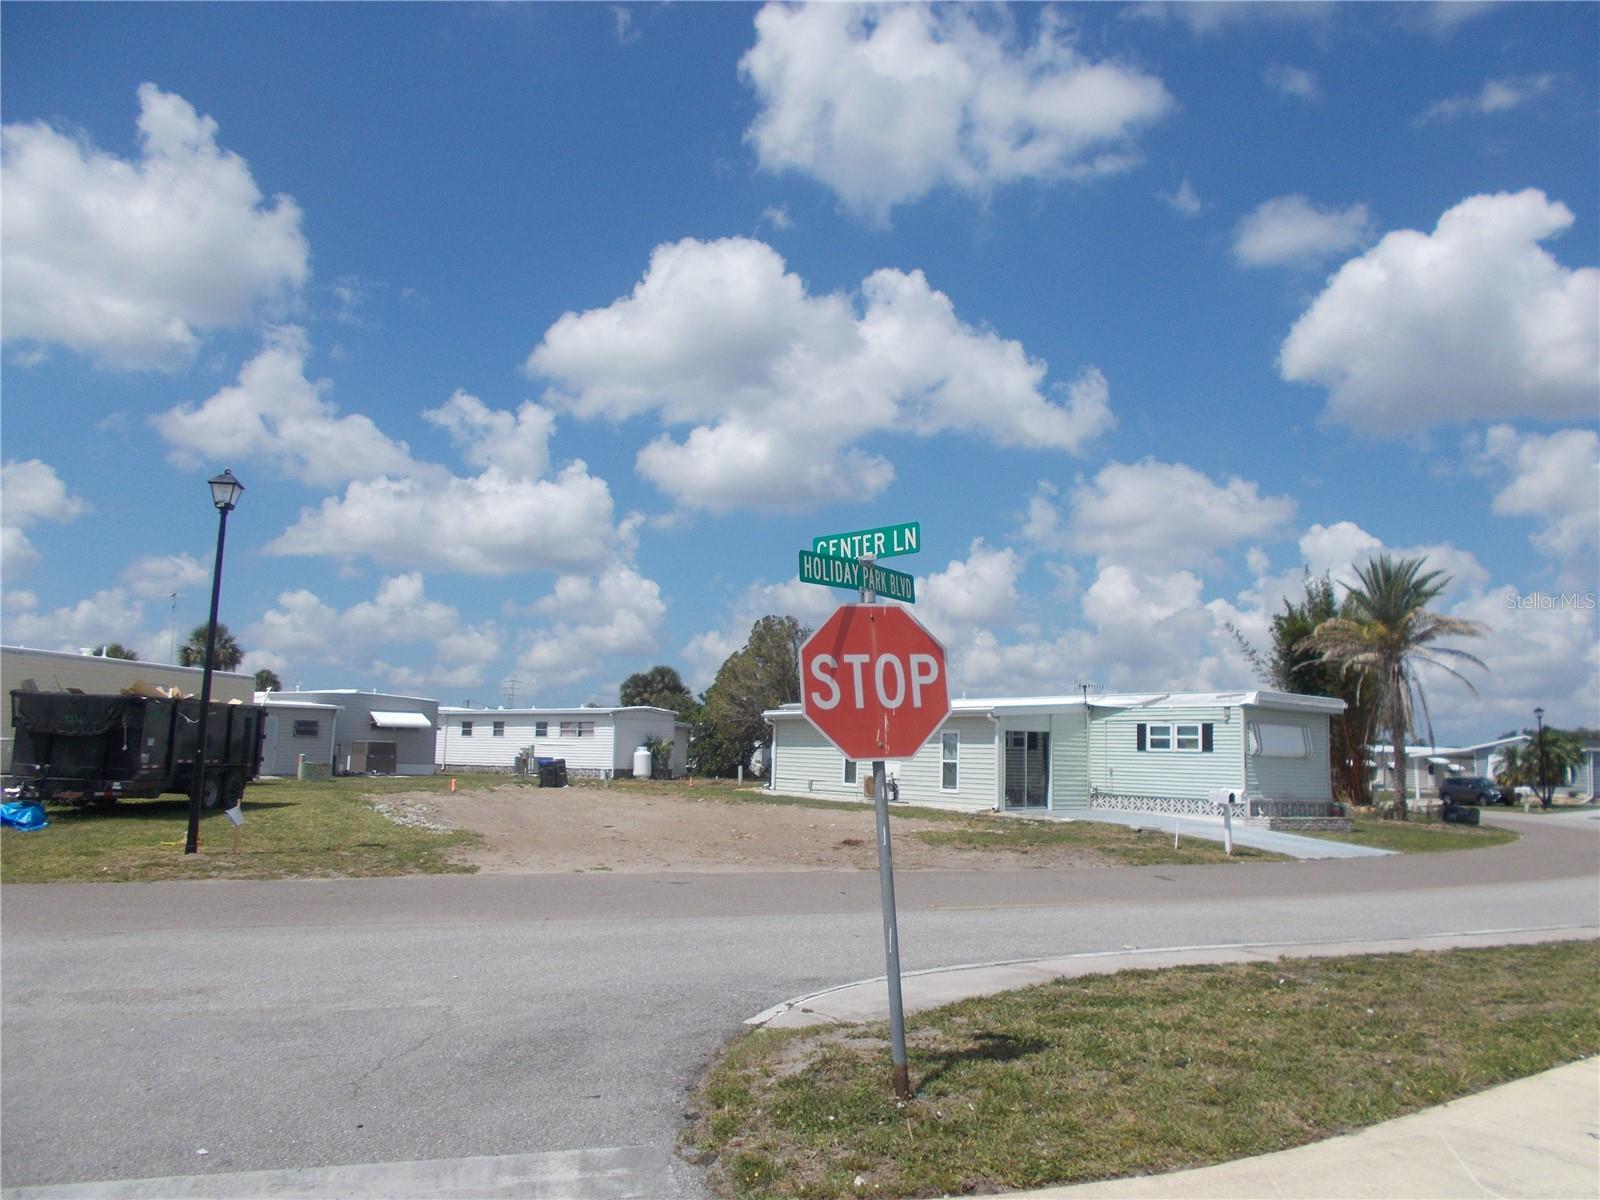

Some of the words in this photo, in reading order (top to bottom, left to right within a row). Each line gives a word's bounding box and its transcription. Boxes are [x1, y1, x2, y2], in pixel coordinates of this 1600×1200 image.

[817, 533, 886, 559] CENTER
[893, 527, 917, 551] LN
[804, 555, 859, 585] HOLIDAY
[863, 566, 887, 593] PARK
[890, 574, 912, 598] BLVD
[811, 653, 939, 710] STOP
